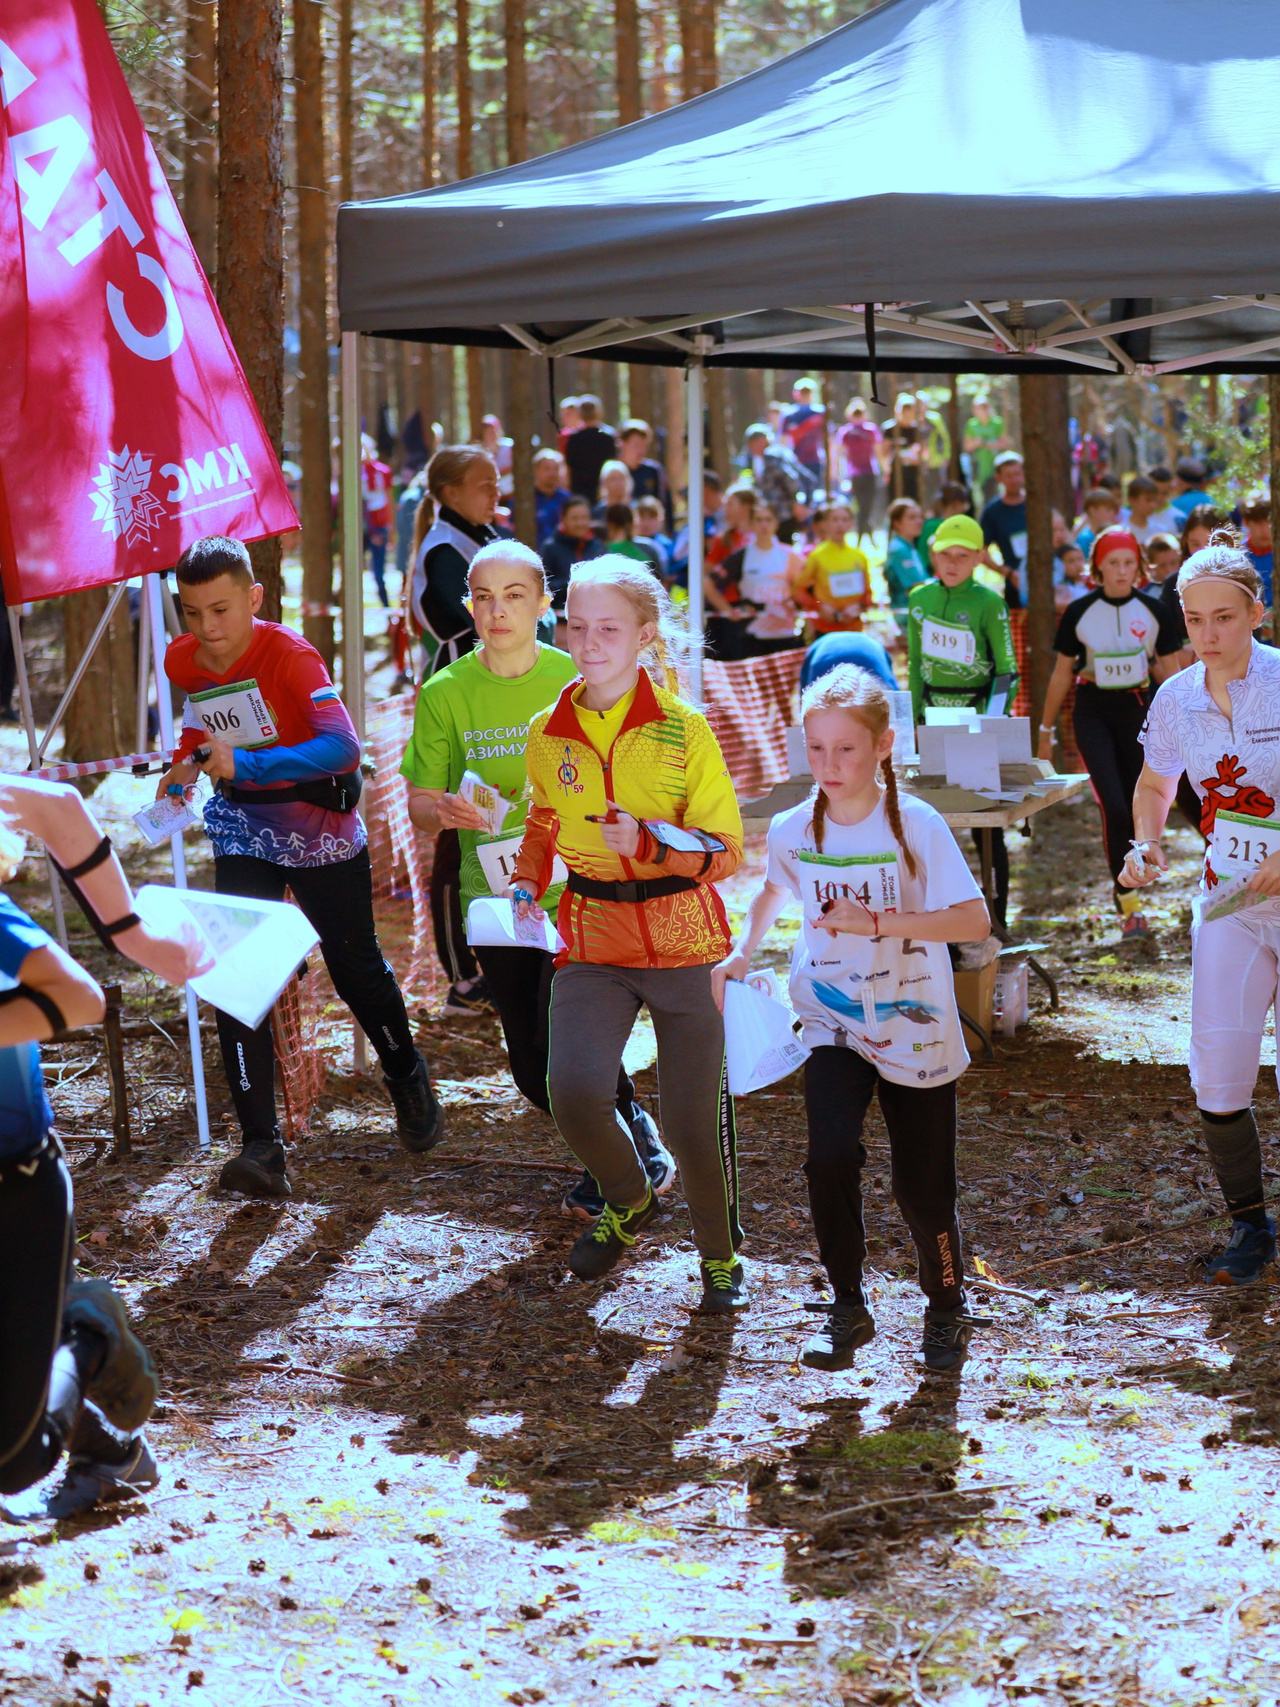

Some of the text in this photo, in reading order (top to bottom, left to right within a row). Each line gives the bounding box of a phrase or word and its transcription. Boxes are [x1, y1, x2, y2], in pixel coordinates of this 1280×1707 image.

[931, 631, 958, 649] 819
[1105, 664, 1132, 677] 919
[202, 706, 241, 734] 806
[246, 693, 263, 725] ПЕРМСКИЙ
[255, 698, 268, 724] ПЕРИОД
[1251, 736, 1279, 744] Елизавета
[573, 784, 584, 793] 59
[1227, 836, 1268, 865] 213
[813, 880, 871, 905] 1014
[879, 867, 889, 906] ПЕРМСКИЙ
[888, 876, 896, 905] ПЕРИОД
[236, 1041, 247, 1078] NORD
